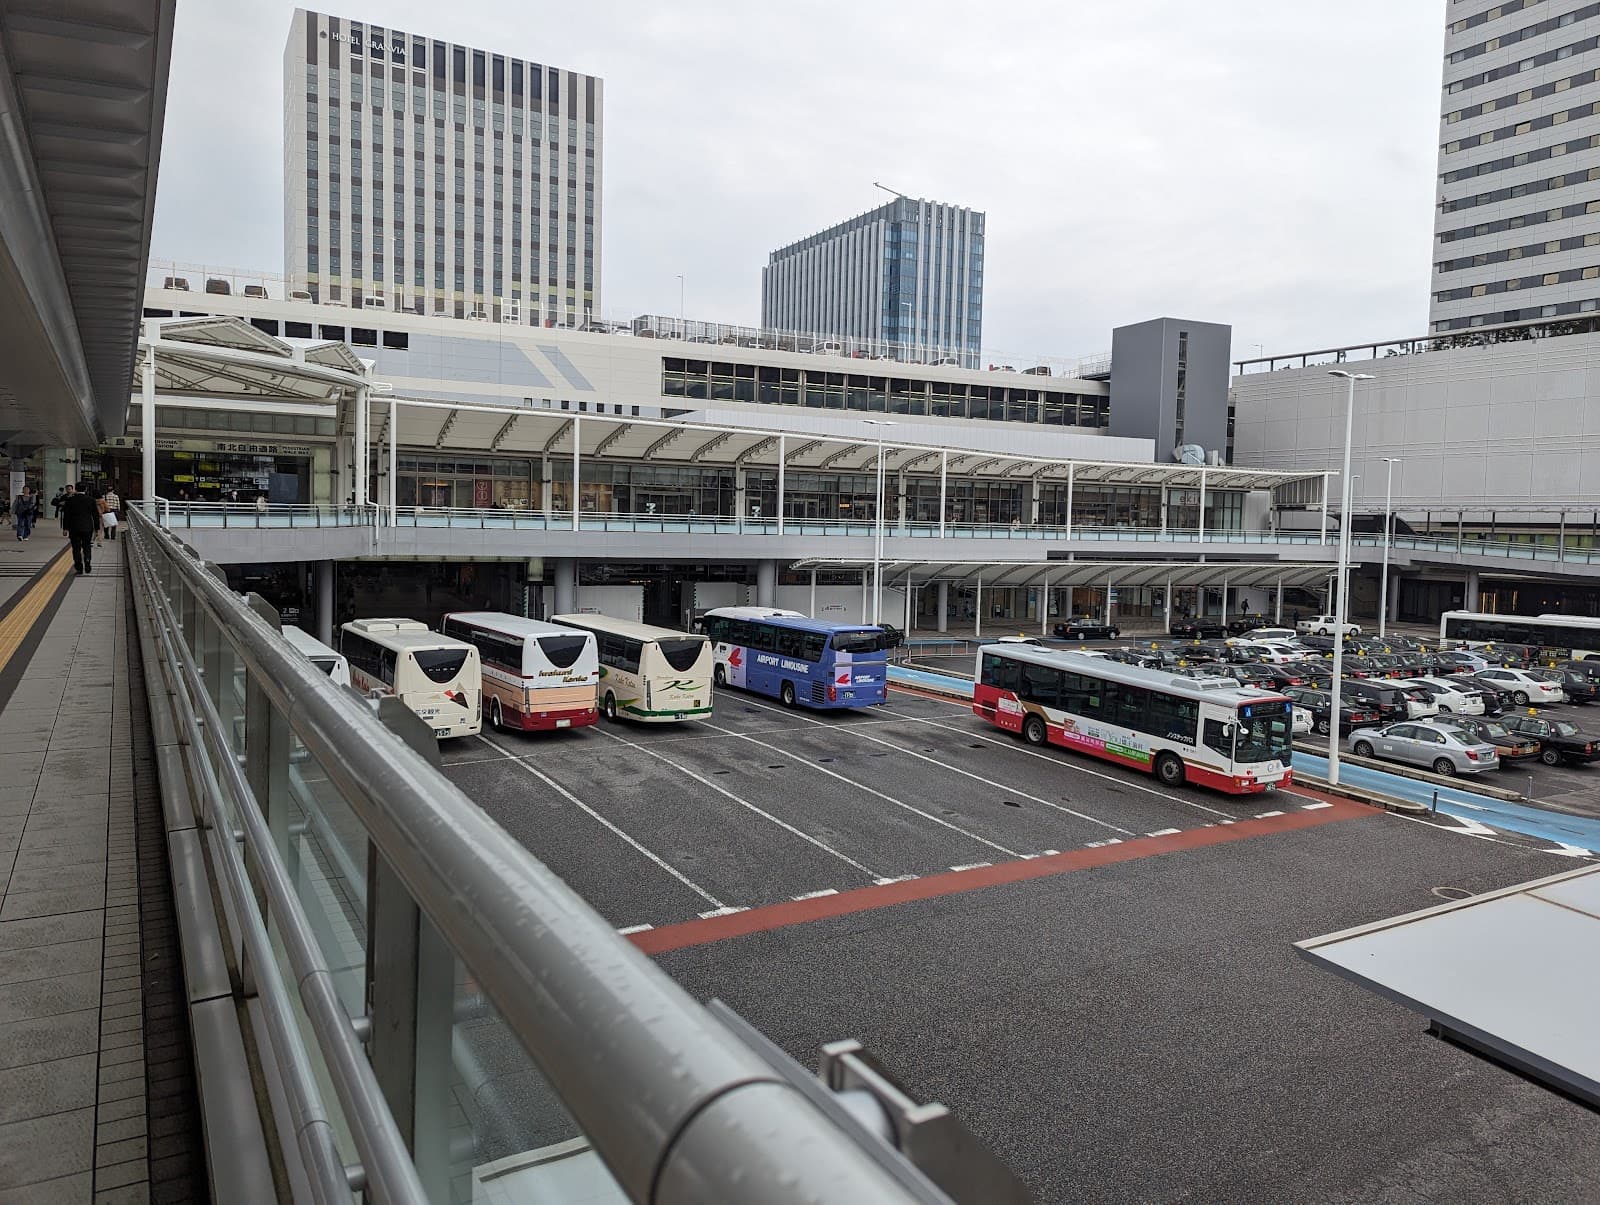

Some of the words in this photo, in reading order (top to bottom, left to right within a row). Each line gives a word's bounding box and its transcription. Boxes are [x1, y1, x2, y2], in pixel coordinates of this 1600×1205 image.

[332, 32, 360, 45] HOTEL
[365, 40, 407, 55] GRANVIA
[216, 443, 278, 454] 南北自由通路
[757, 654, 779, 667] AIRPORT
[781, 659, 809, 674] LIMOUSINE
